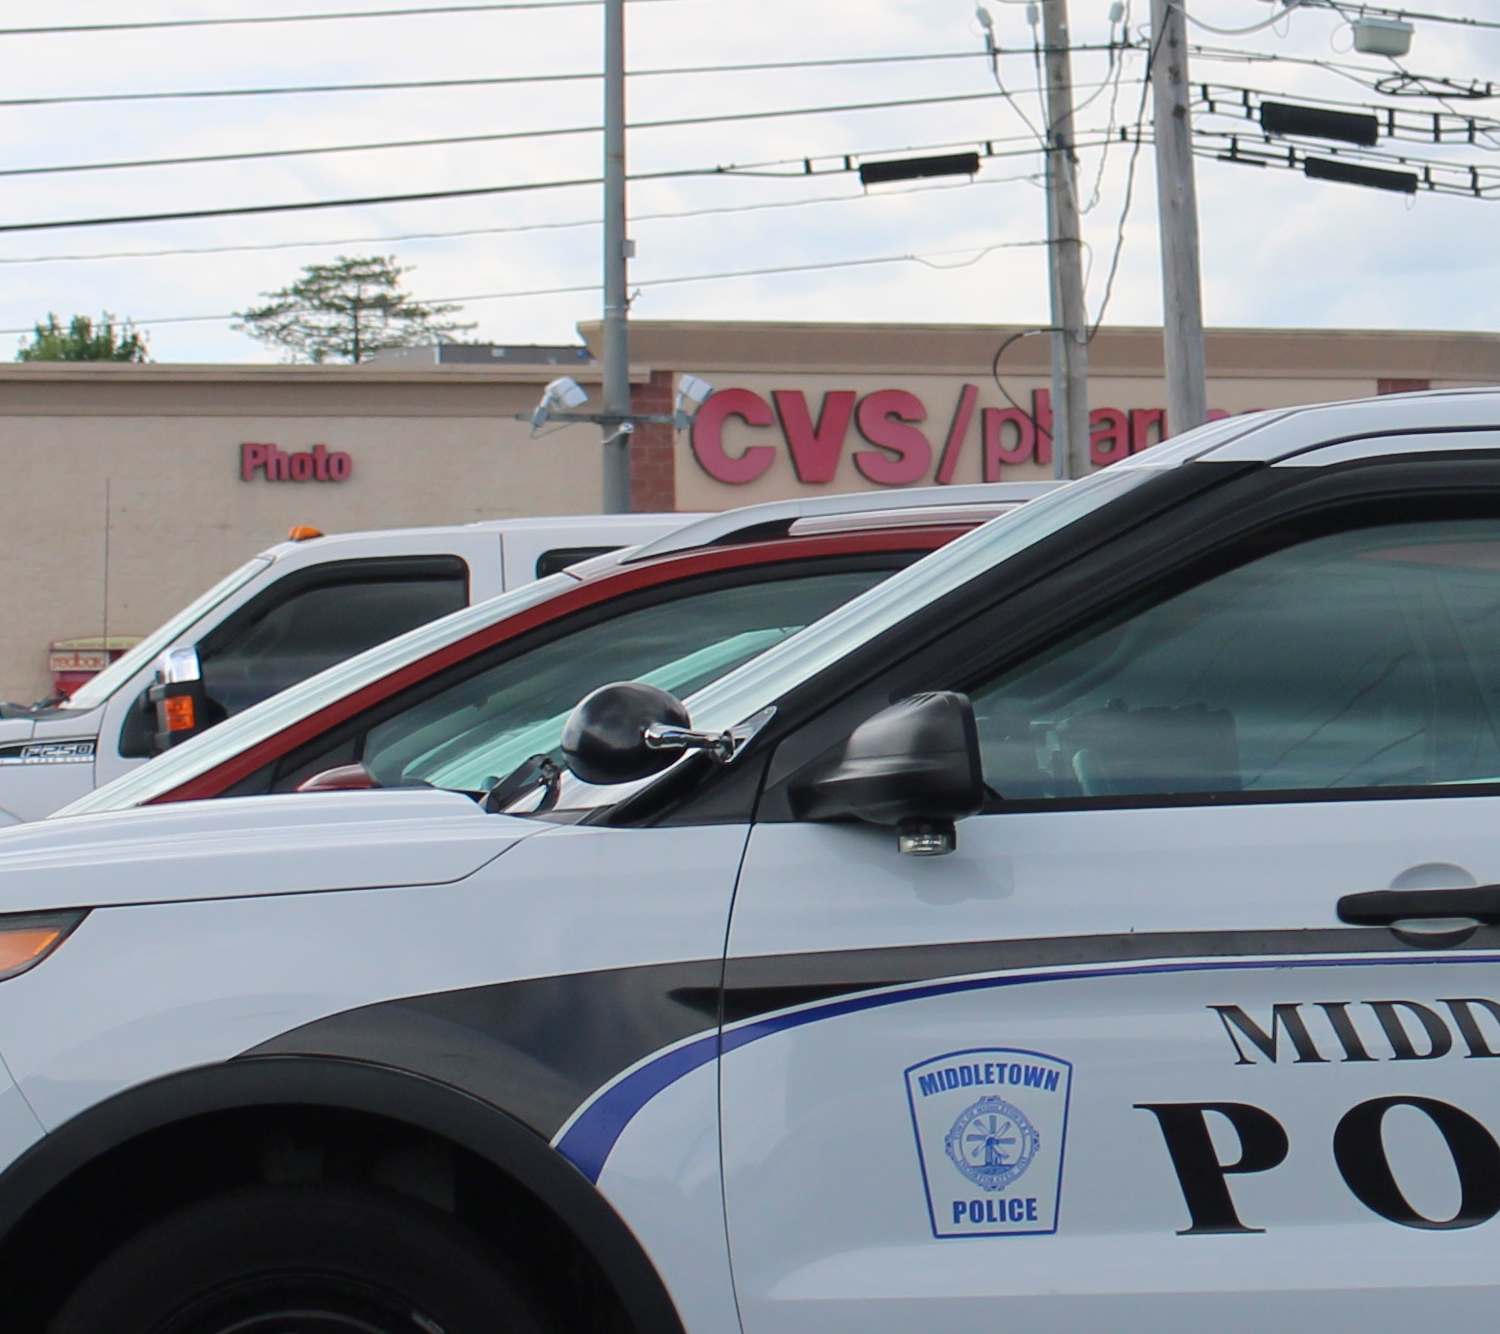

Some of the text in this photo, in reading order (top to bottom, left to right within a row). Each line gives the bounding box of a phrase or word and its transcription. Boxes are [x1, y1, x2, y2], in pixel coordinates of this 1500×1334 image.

[240, 442, 352, 481] Photo
[918, 1063, 1060, 1097] MIDDLETOWN
[953, 1198, 1038, 1224] POLICE
